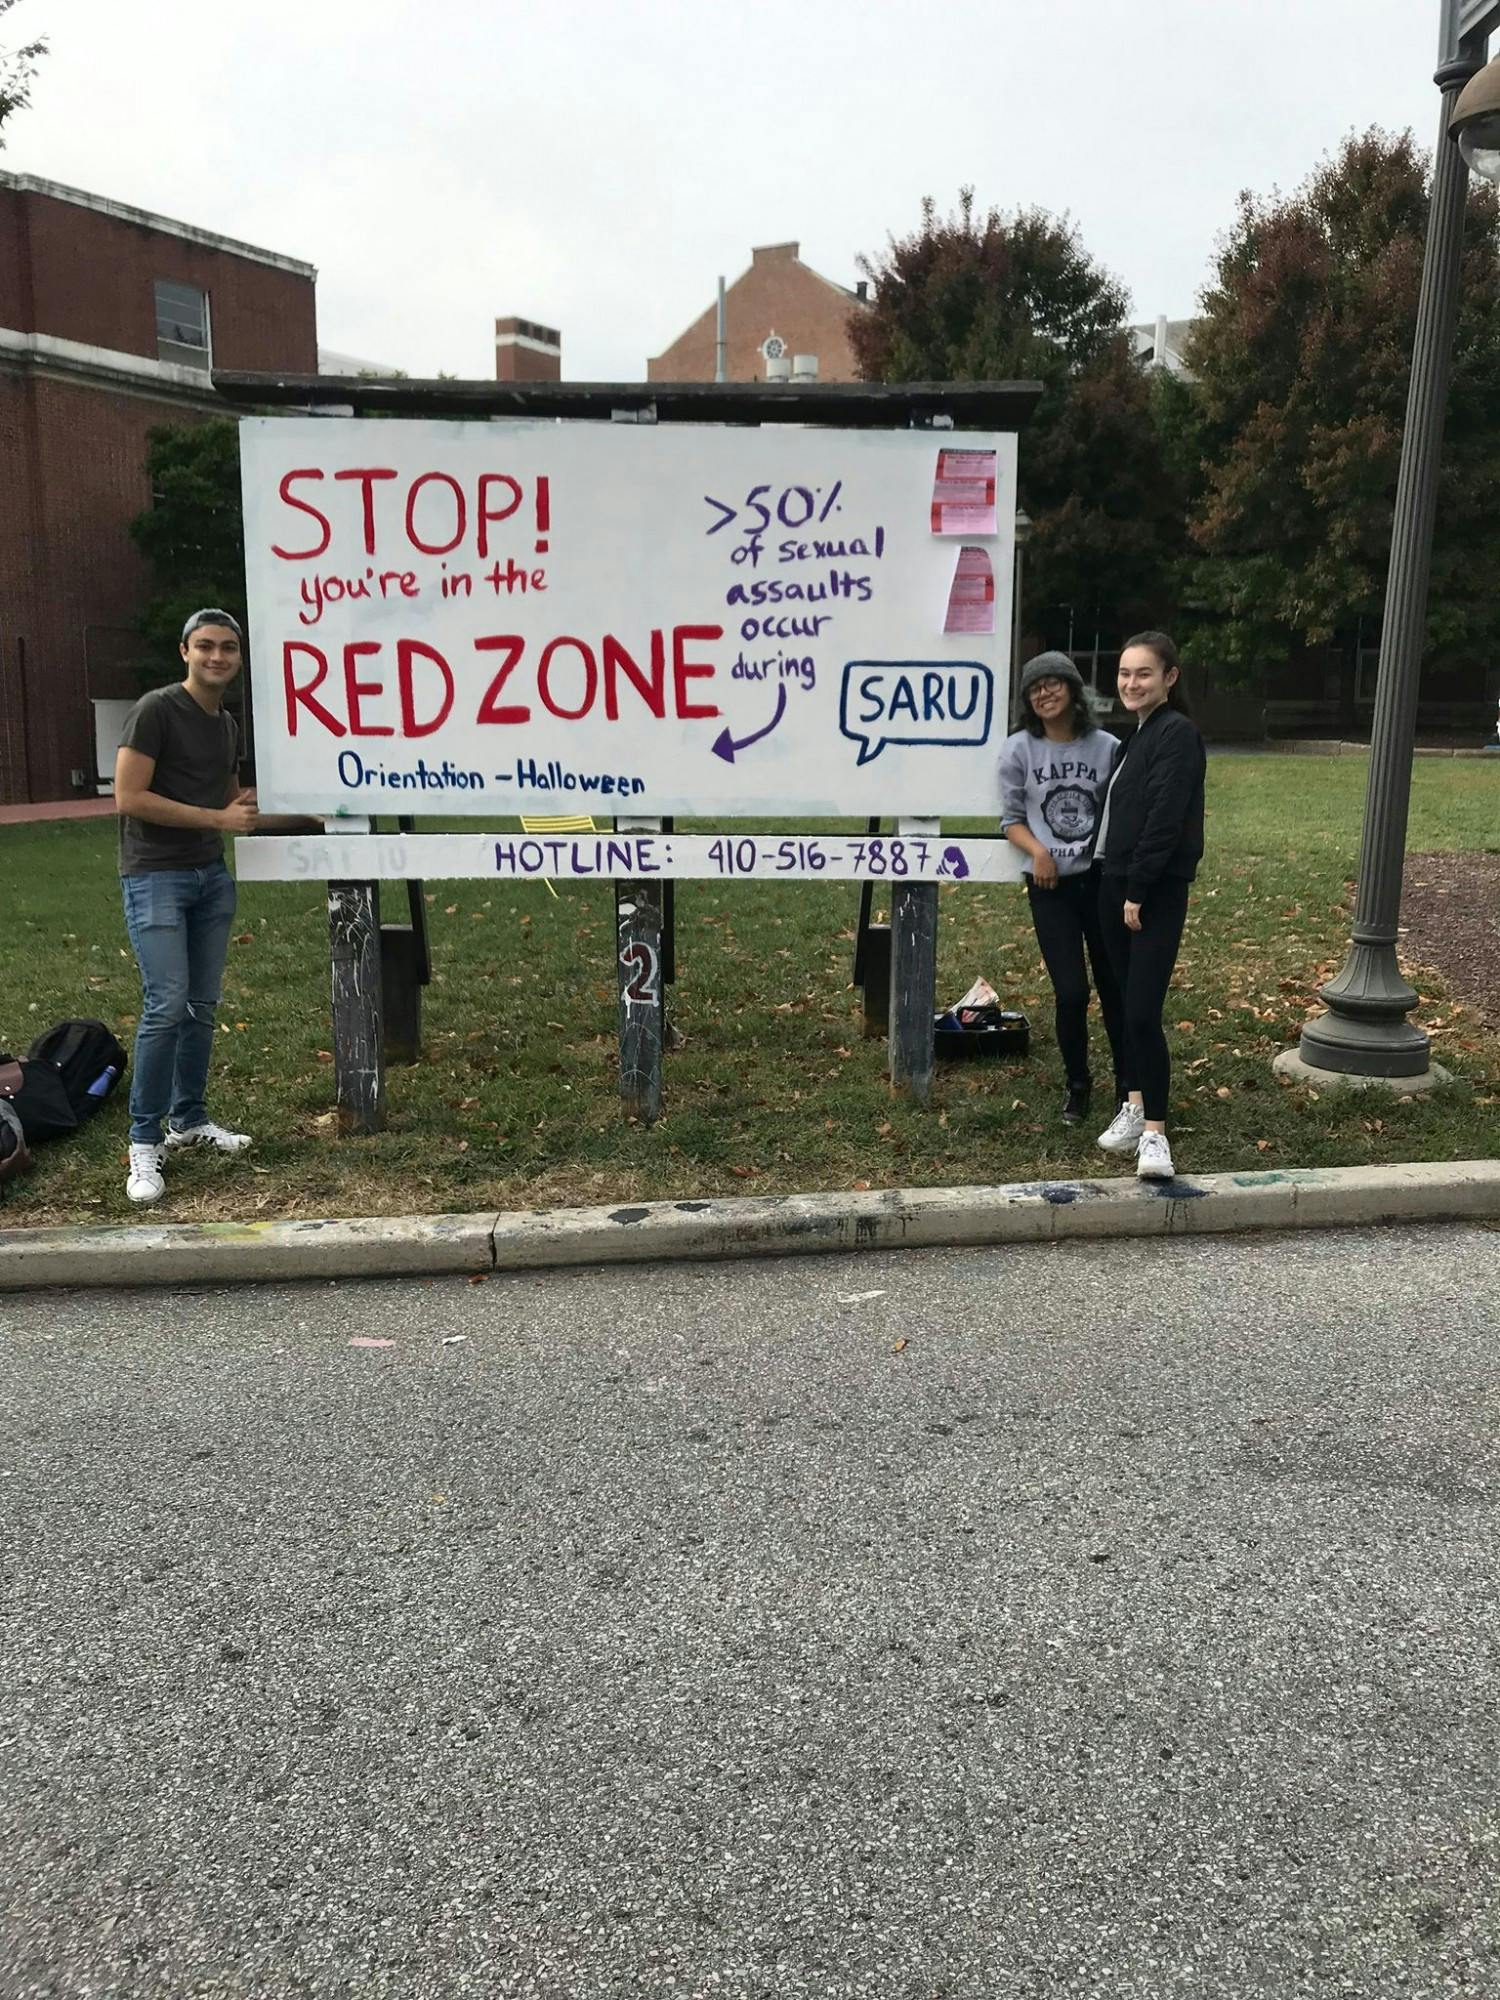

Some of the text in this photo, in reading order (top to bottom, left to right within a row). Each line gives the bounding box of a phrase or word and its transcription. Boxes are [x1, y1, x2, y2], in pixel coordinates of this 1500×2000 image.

[272, 468, 550, 560] STOP!
[704, 481, 842, 534] >50%
[731, 526, 885, 568] of sexual
[299, 558, 548, 624] you're in the
[726, 569, 872, 605] assaults
[741, 615, 832, 641] occur
[283, 625, 724, 738] RED ZONE
[731, 650, 816, 691] during
[860, 673, 979, 723] SARU
[338, 751, 485, 789] Orientation
[1032, 761, 1099, 785] KAPPA
[494, 838, 932, 876] HOTLINE: 410-516-7887
[619, 941, 660, 1007] 2
